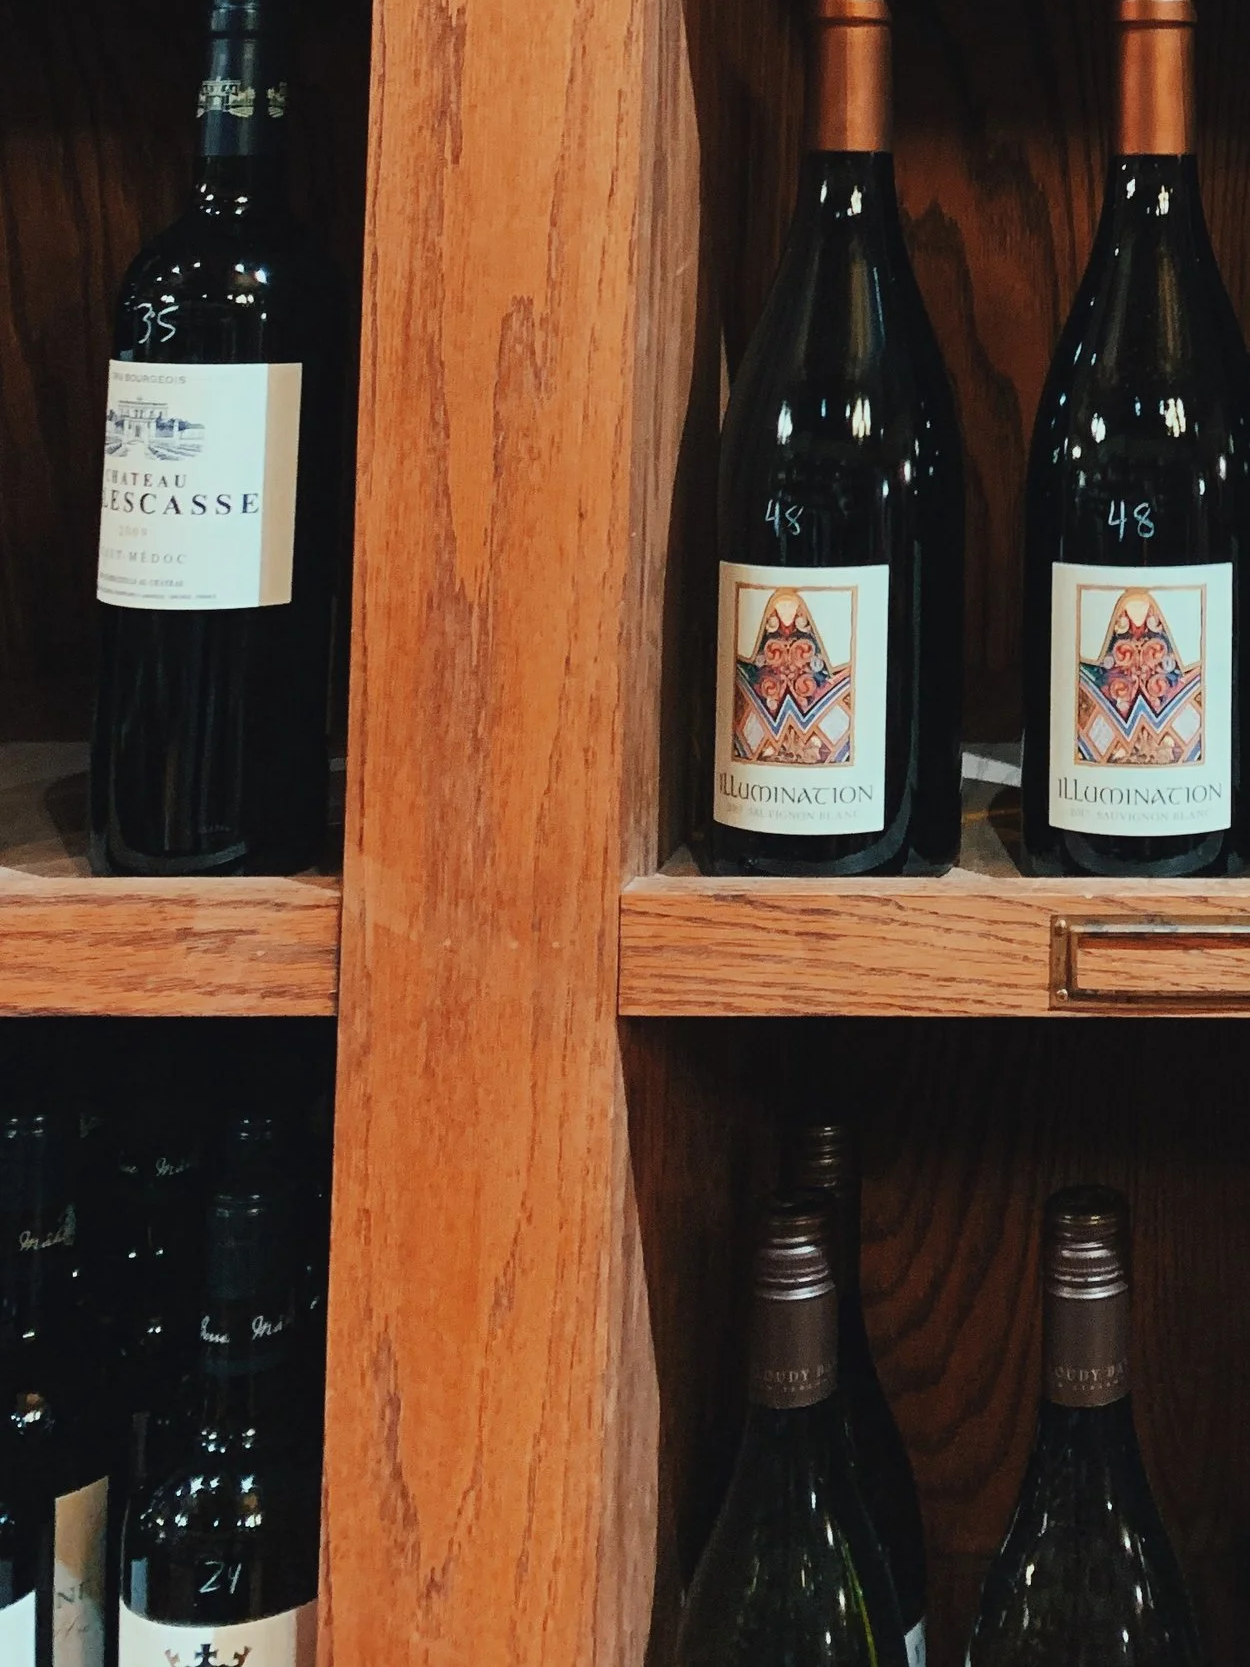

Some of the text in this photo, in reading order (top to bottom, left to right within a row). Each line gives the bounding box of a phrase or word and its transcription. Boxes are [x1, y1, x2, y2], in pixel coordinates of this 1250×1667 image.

[134, 302, 179, 344] 35
[764, 499, 804, 538] 48
[1107, 499, 1155, 542] 48
[719, 772, 874, 805] ILLUMINATION
[1057, 776, 1223, 806] ILLUMINATION
